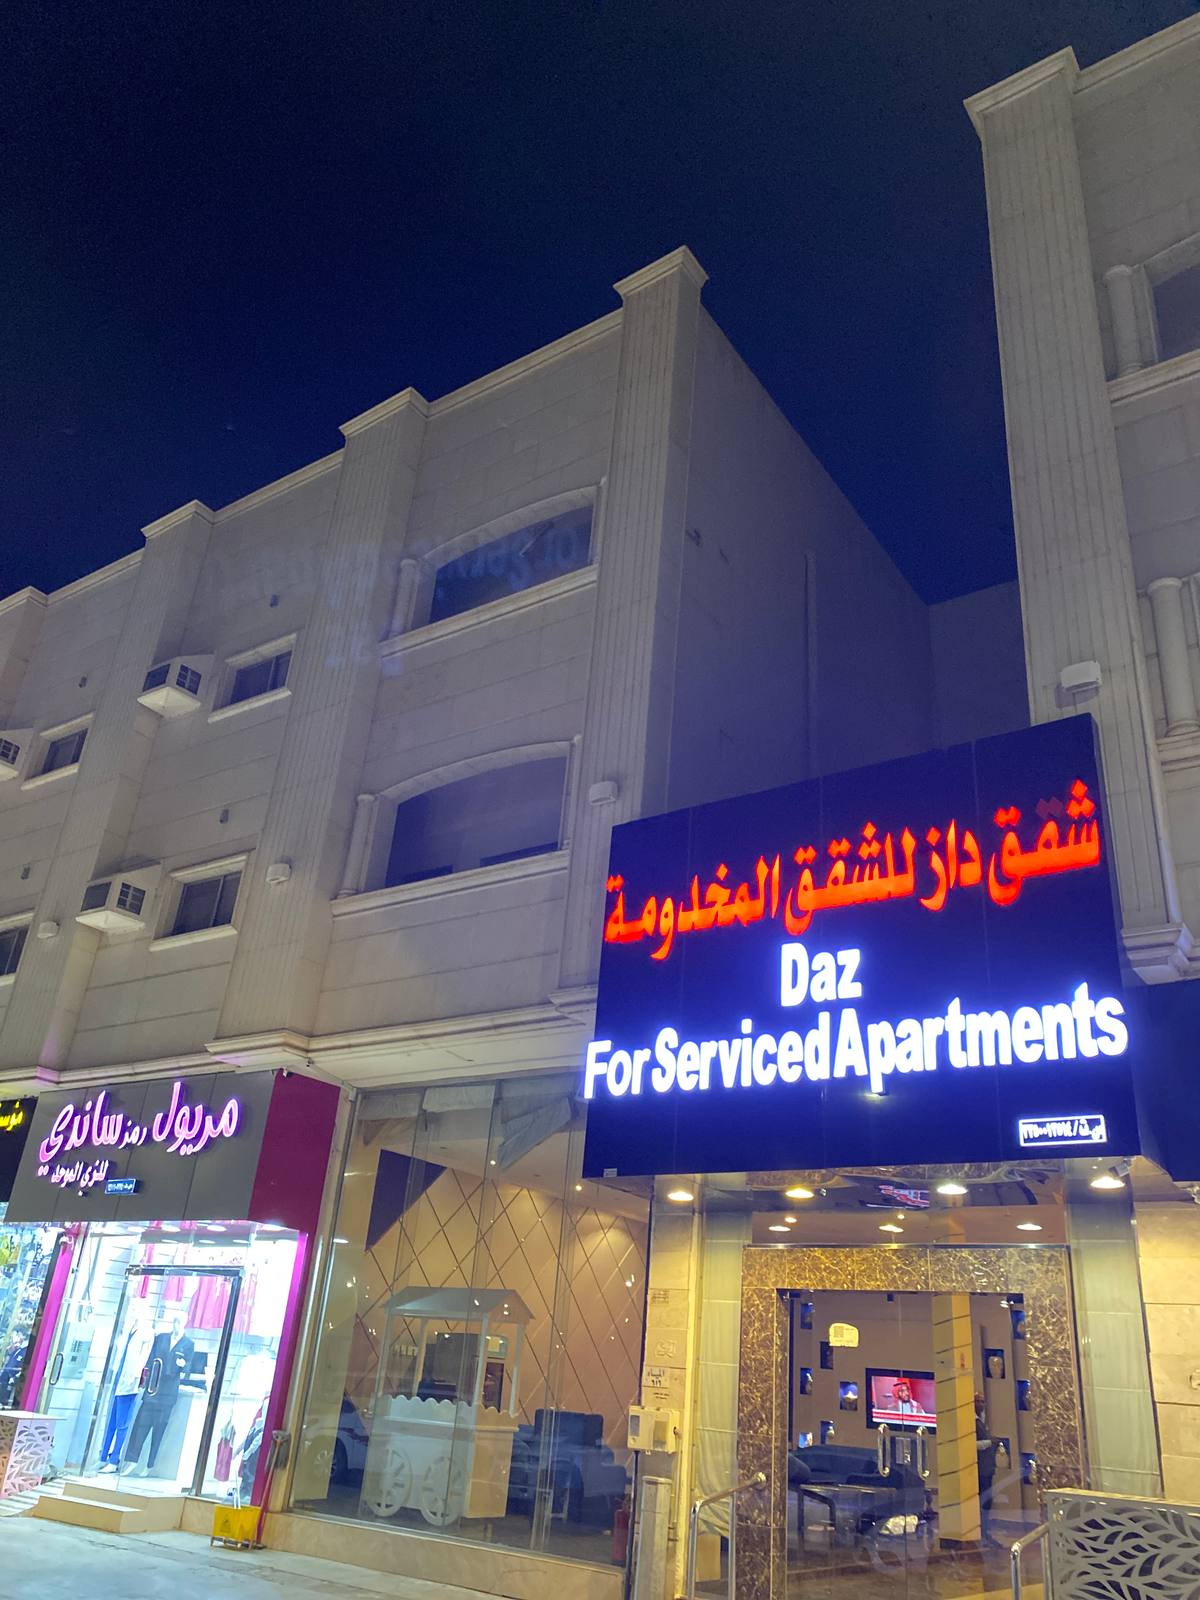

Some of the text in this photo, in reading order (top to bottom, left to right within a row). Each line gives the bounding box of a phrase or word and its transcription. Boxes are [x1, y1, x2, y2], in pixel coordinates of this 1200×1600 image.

[605, 778, 1099, 961] شقق داز للشقق المخدومة
[780, 942, 862, 1007] Daz
[583, 982, 1128, 1099] For Serviced Apartments
[38, 1089, 124, 1177] ساندي
[152, 1081, 239, 1156] مريول
